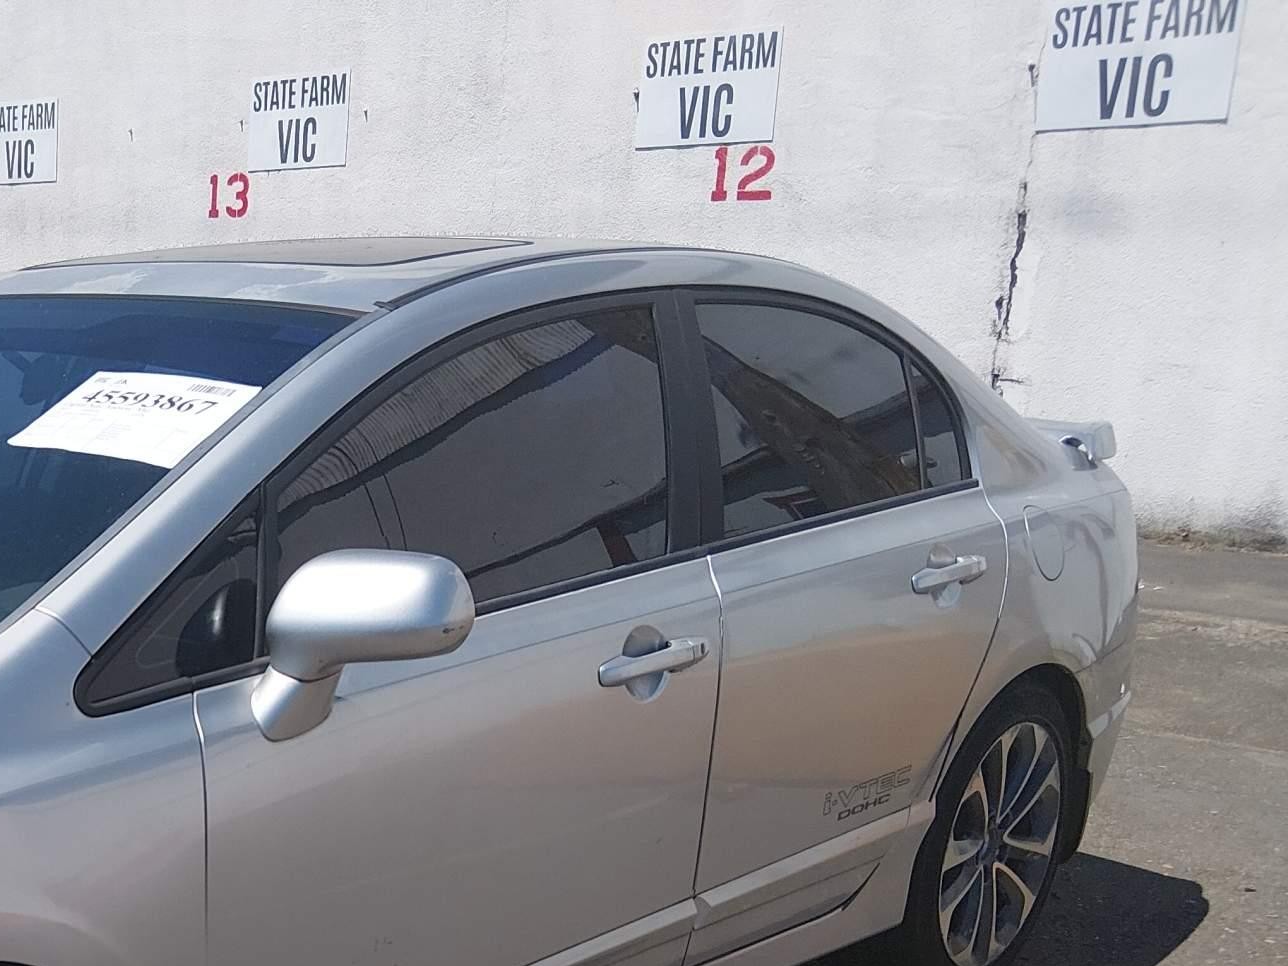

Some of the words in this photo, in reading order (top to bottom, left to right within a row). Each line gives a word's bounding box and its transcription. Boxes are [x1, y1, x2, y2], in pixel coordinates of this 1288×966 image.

[1052, 0, 1139, 49] STATE
[1144, 0, 1238, 41] FARM
[646, 37, 706, 79] STATE
[712, 31, 778, 73] FARM
[253, 78, 296, 112] STATE
[300, 73, 347, 108] FARM
[1098, 53, 1174, 120] VIC
[21, 102, 55, 131] FARM
[679, 83, 734, 139] VIC
[5, 139, 35, 179] VIC
[277, 117, 317, 164] VIC
[208, 172, 249, 218] 13
[711, 146, 775, 201] 12
[81, 388, 219, 415] 45593867
[837, 793, 892, 821] DOHC
